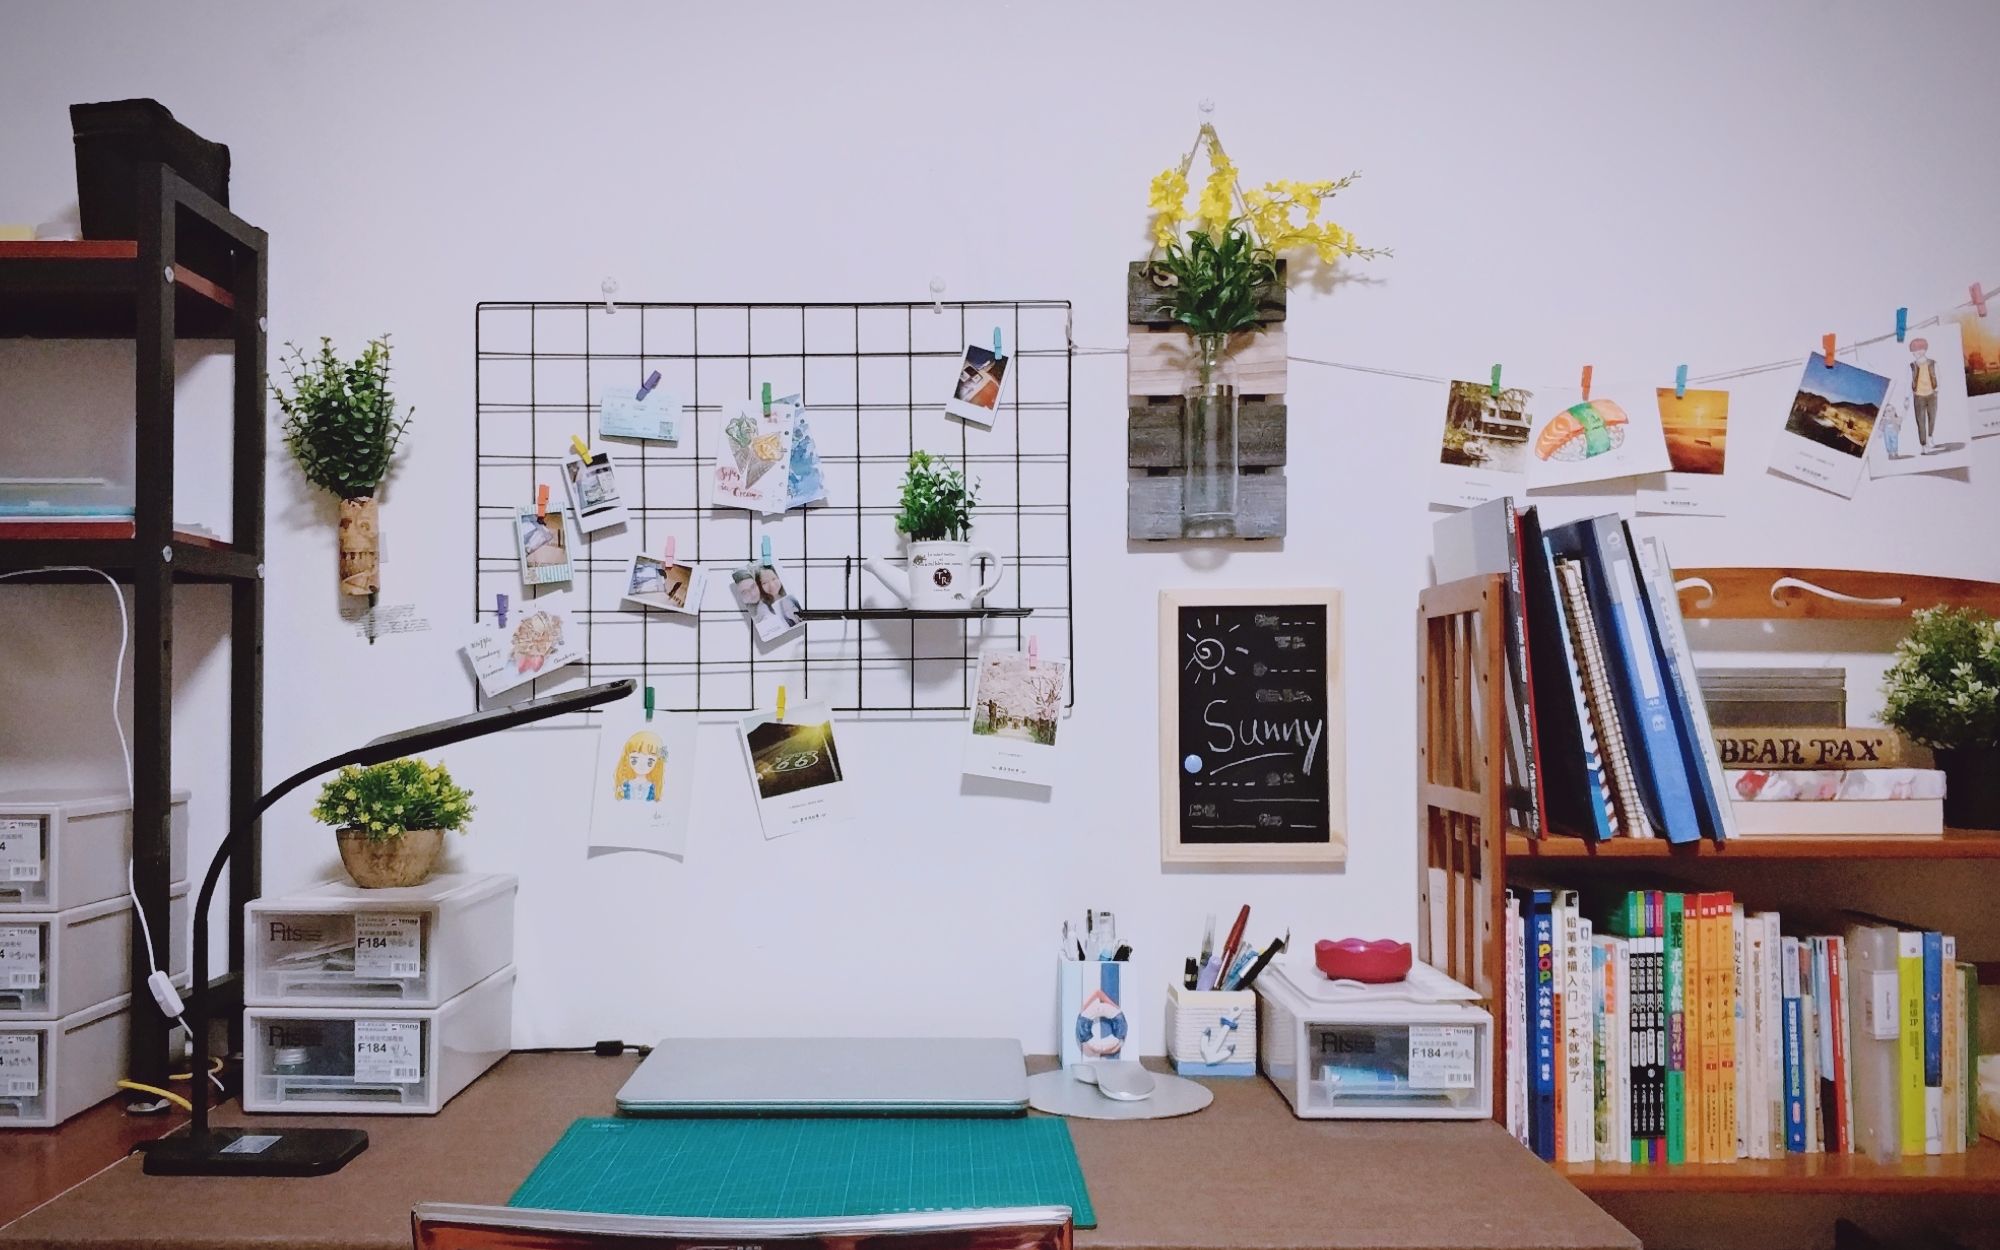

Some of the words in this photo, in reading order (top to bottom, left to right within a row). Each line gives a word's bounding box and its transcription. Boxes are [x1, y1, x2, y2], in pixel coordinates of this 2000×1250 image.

[1204, 699, 1323, 776] Sunny
[1717, 739, 1804, 764] BEAR
[1810, 739, 1882, 764] FAX
[357, 937, 387, 949] F184
[357, 1042, 387, 1053] F184
[1411, 1047, 1441, 1058] F184
